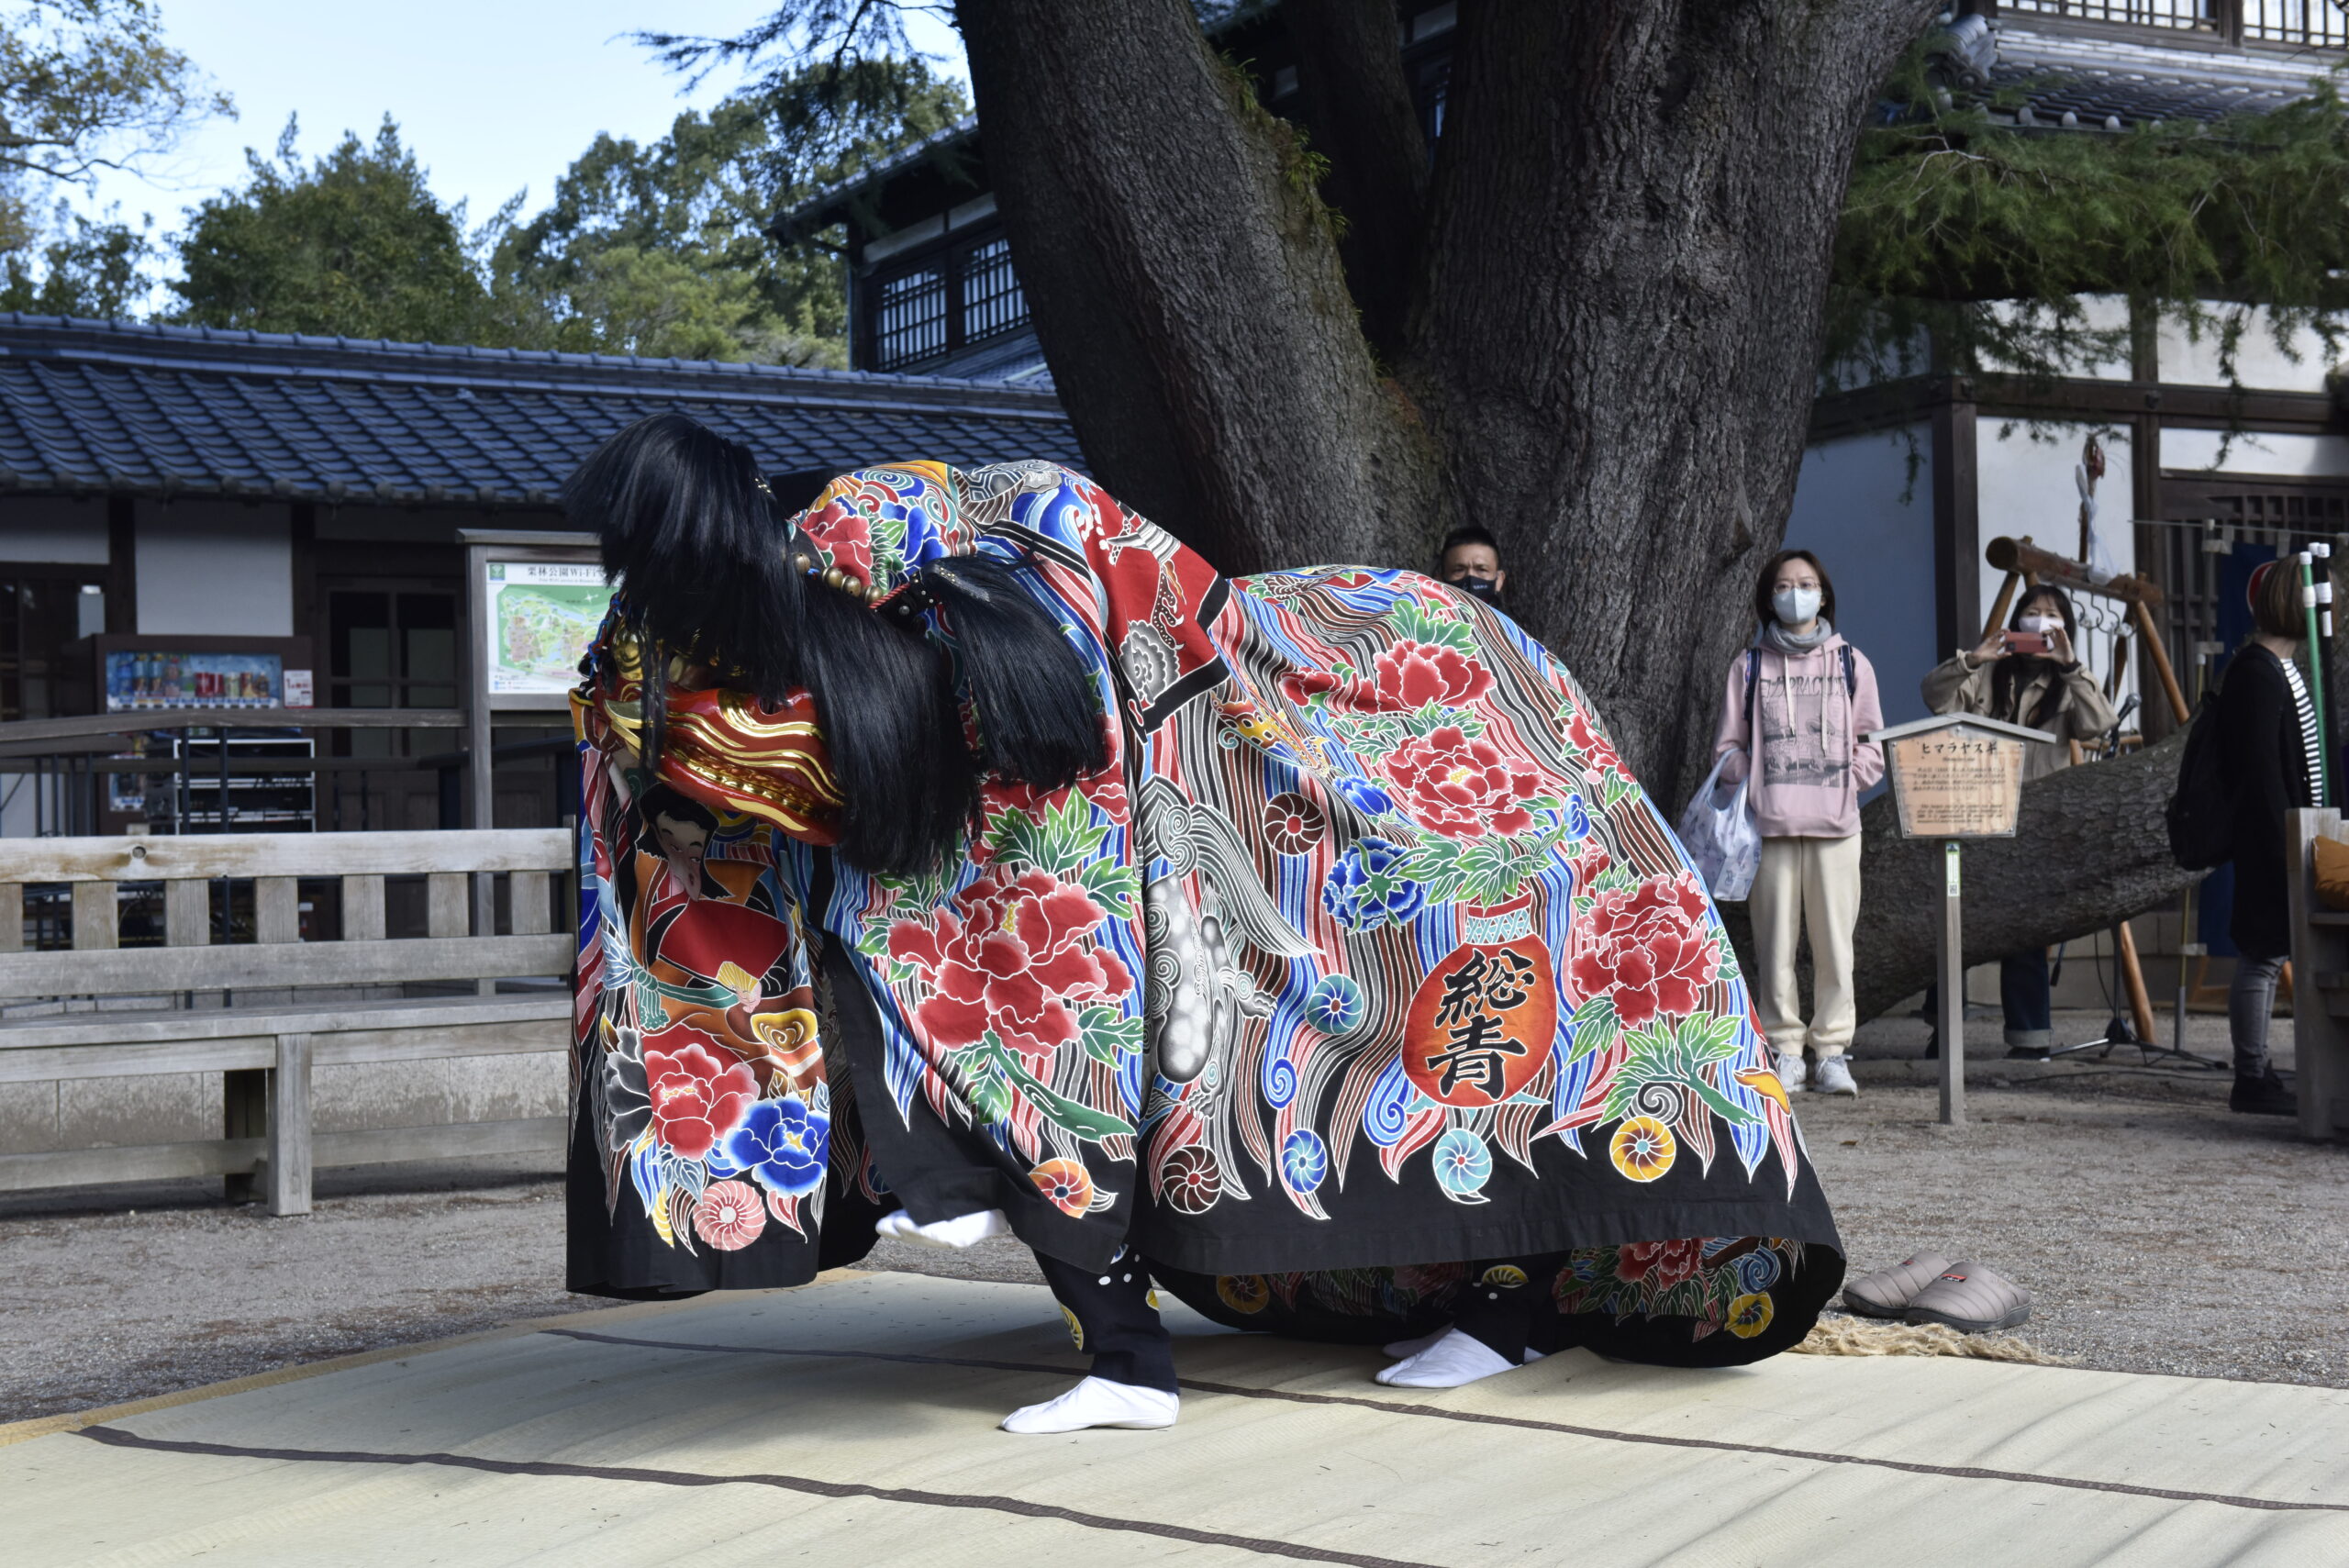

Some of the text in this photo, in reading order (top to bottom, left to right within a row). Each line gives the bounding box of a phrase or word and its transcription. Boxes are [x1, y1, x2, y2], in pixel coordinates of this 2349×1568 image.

[1921, 740, 1998, 755] ヒマラヤスギ
[1428, 949, 1534, 1099] 総青
